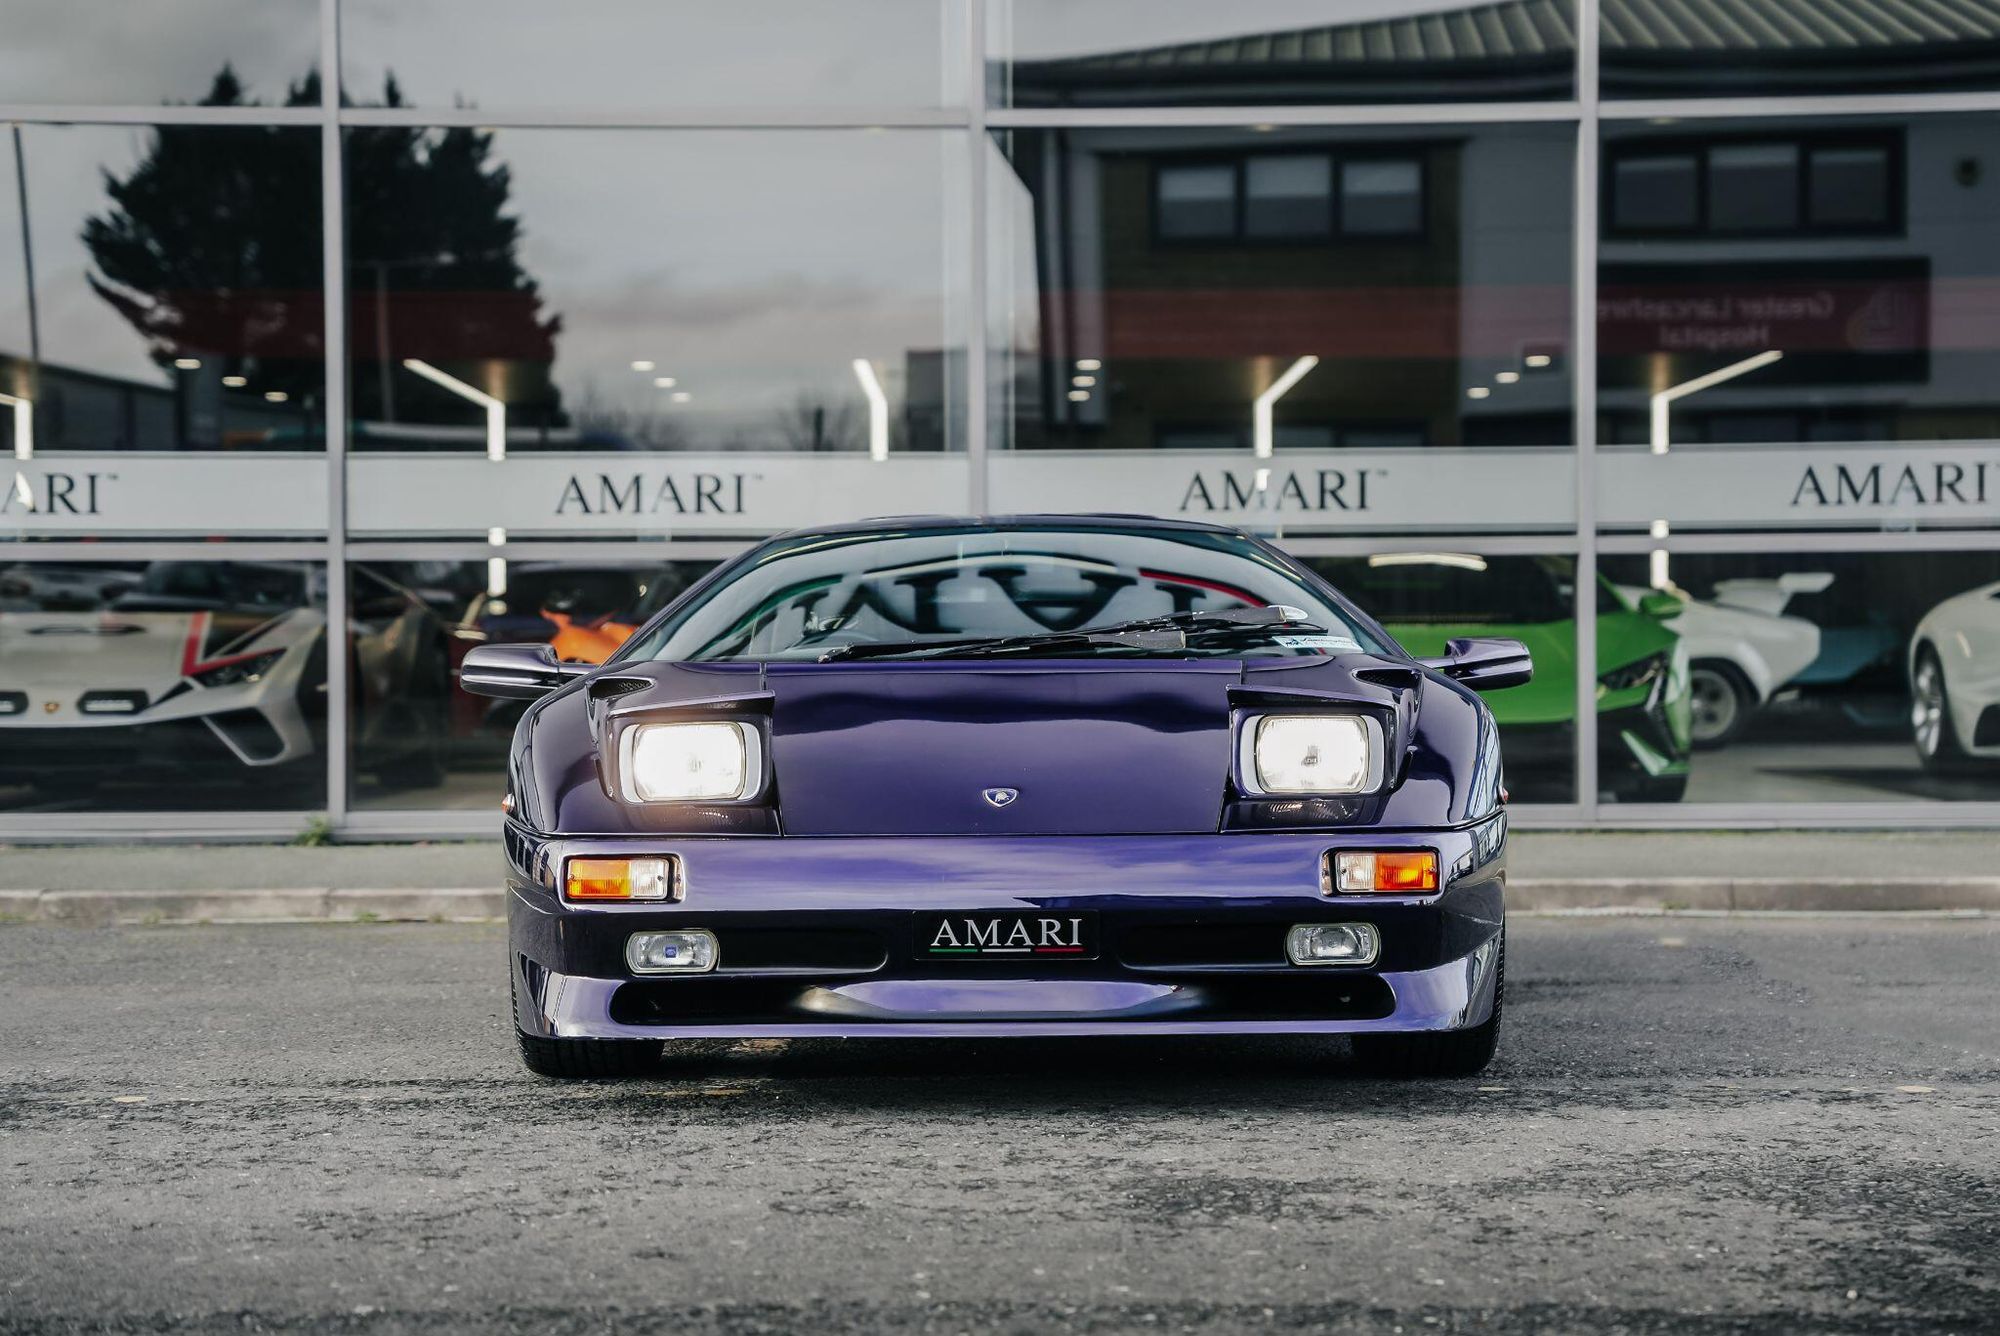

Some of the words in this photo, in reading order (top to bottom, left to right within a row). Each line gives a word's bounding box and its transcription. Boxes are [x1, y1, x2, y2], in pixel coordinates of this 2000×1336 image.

[555, 472, 746, 515] AMARI
[1178, 469, 1370, 511] AMARI
[1790, 461, 1990, 507] AMARI
[930, 918, 1083, 947] AMARI
